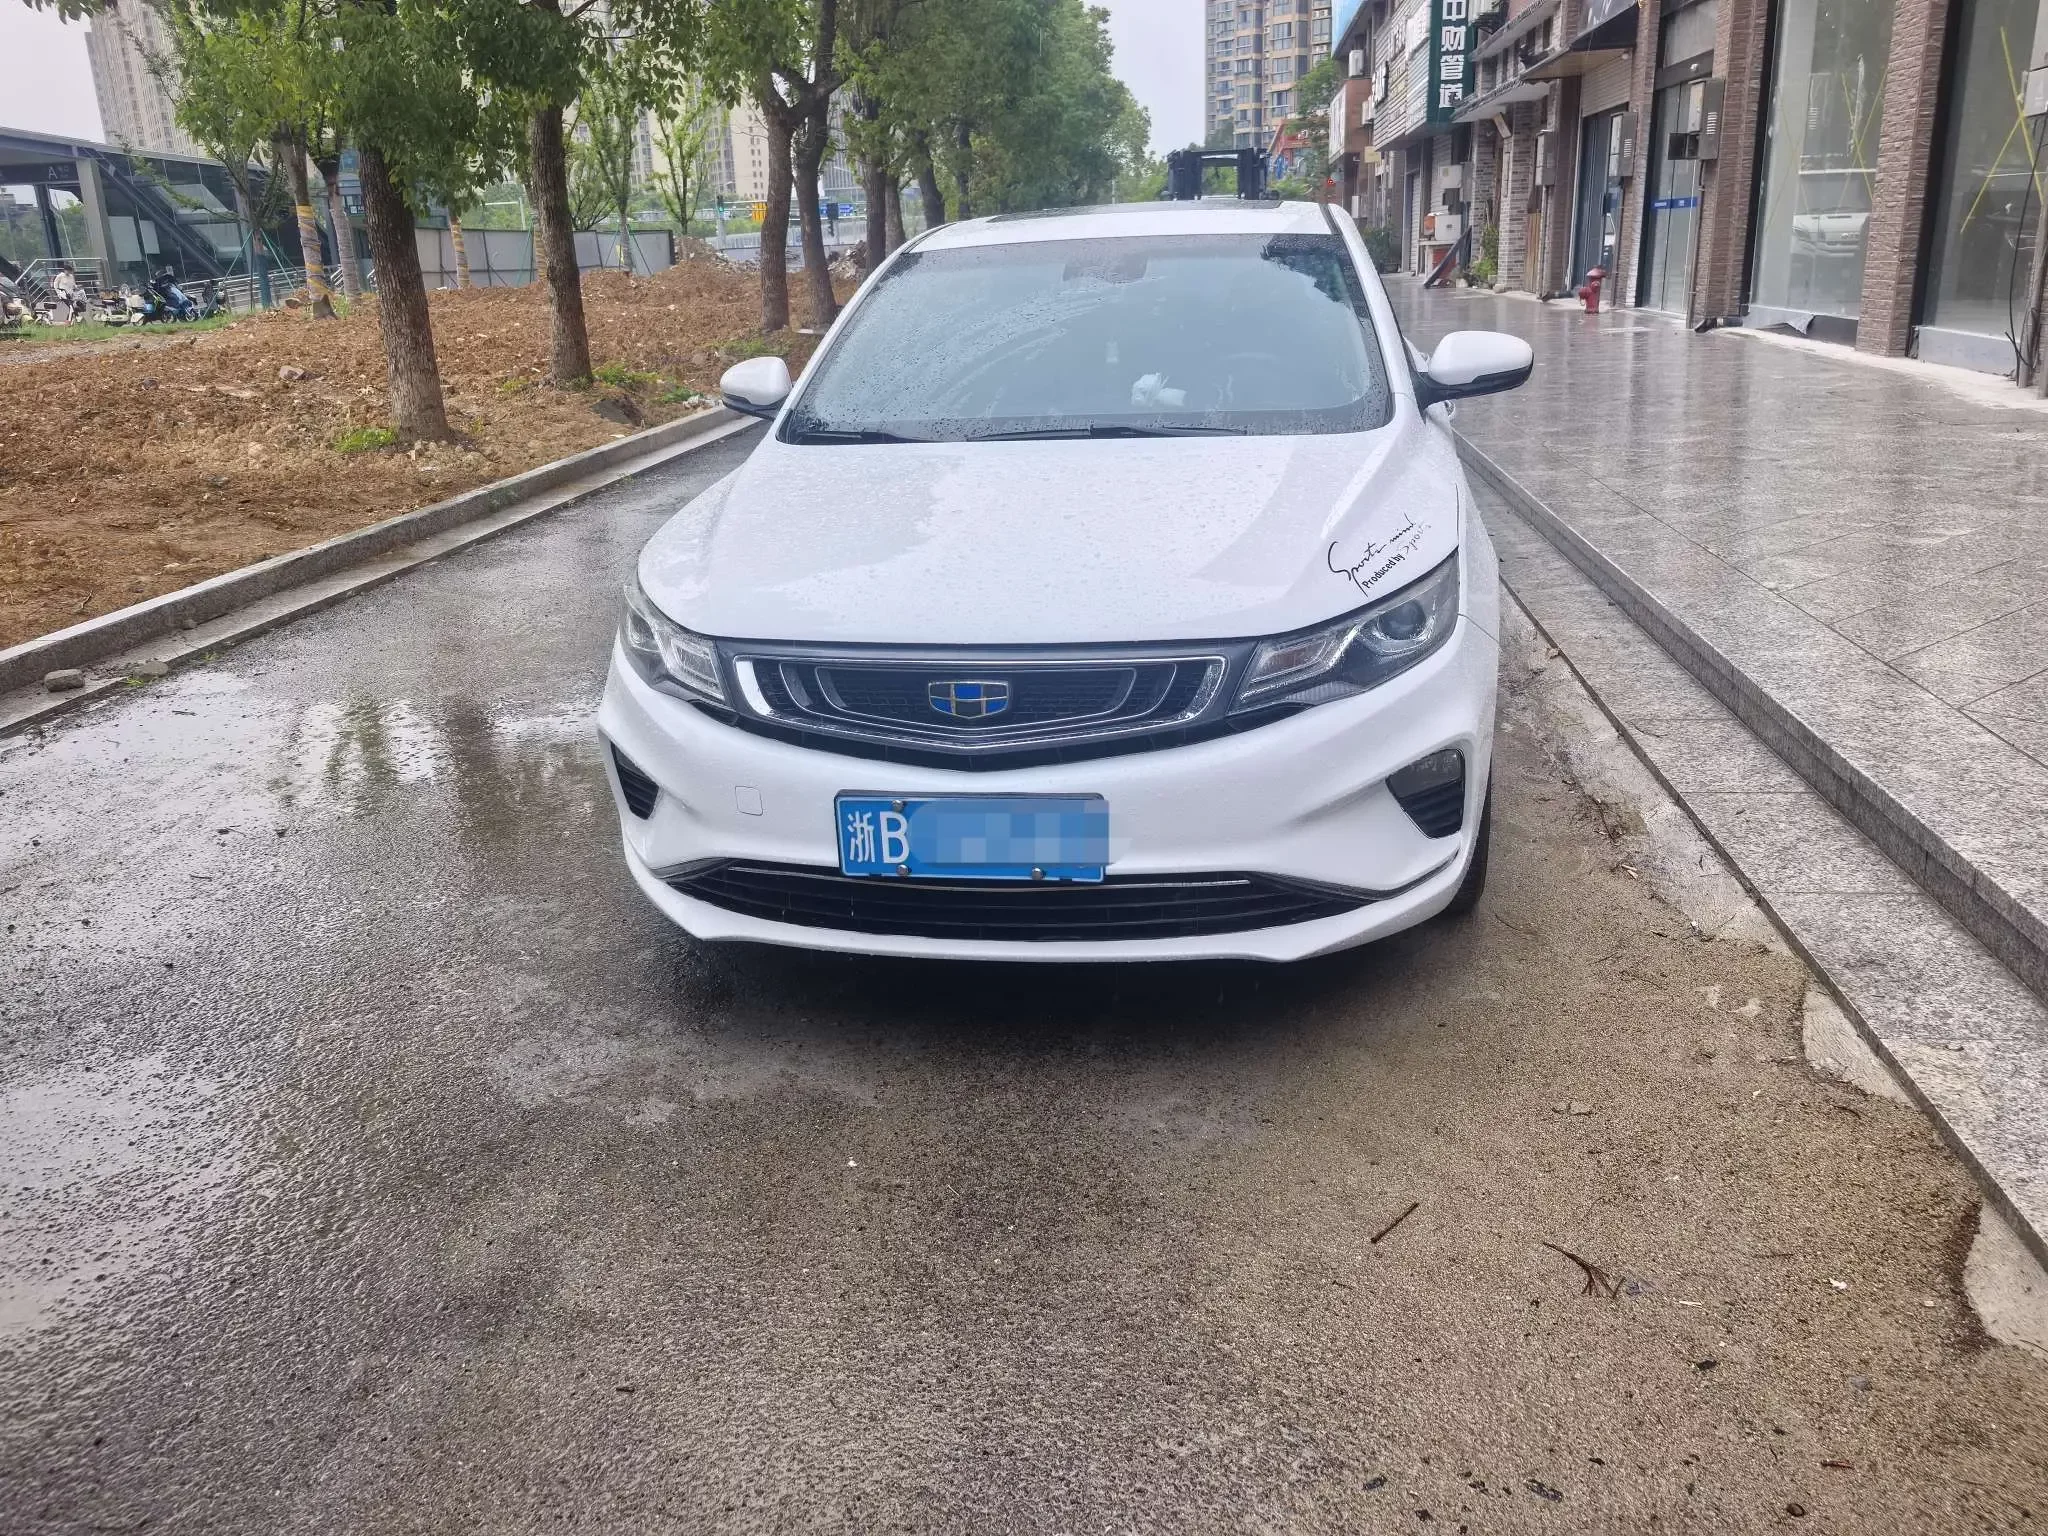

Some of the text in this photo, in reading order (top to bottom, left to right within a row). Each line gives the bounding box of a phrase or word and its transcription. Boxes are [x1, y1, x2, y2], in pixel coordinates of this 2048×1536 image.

[48, 166, 58, 180] A
[1362, 558, 1397, 588] Produced
[1391, 553, 1405, 562] by
